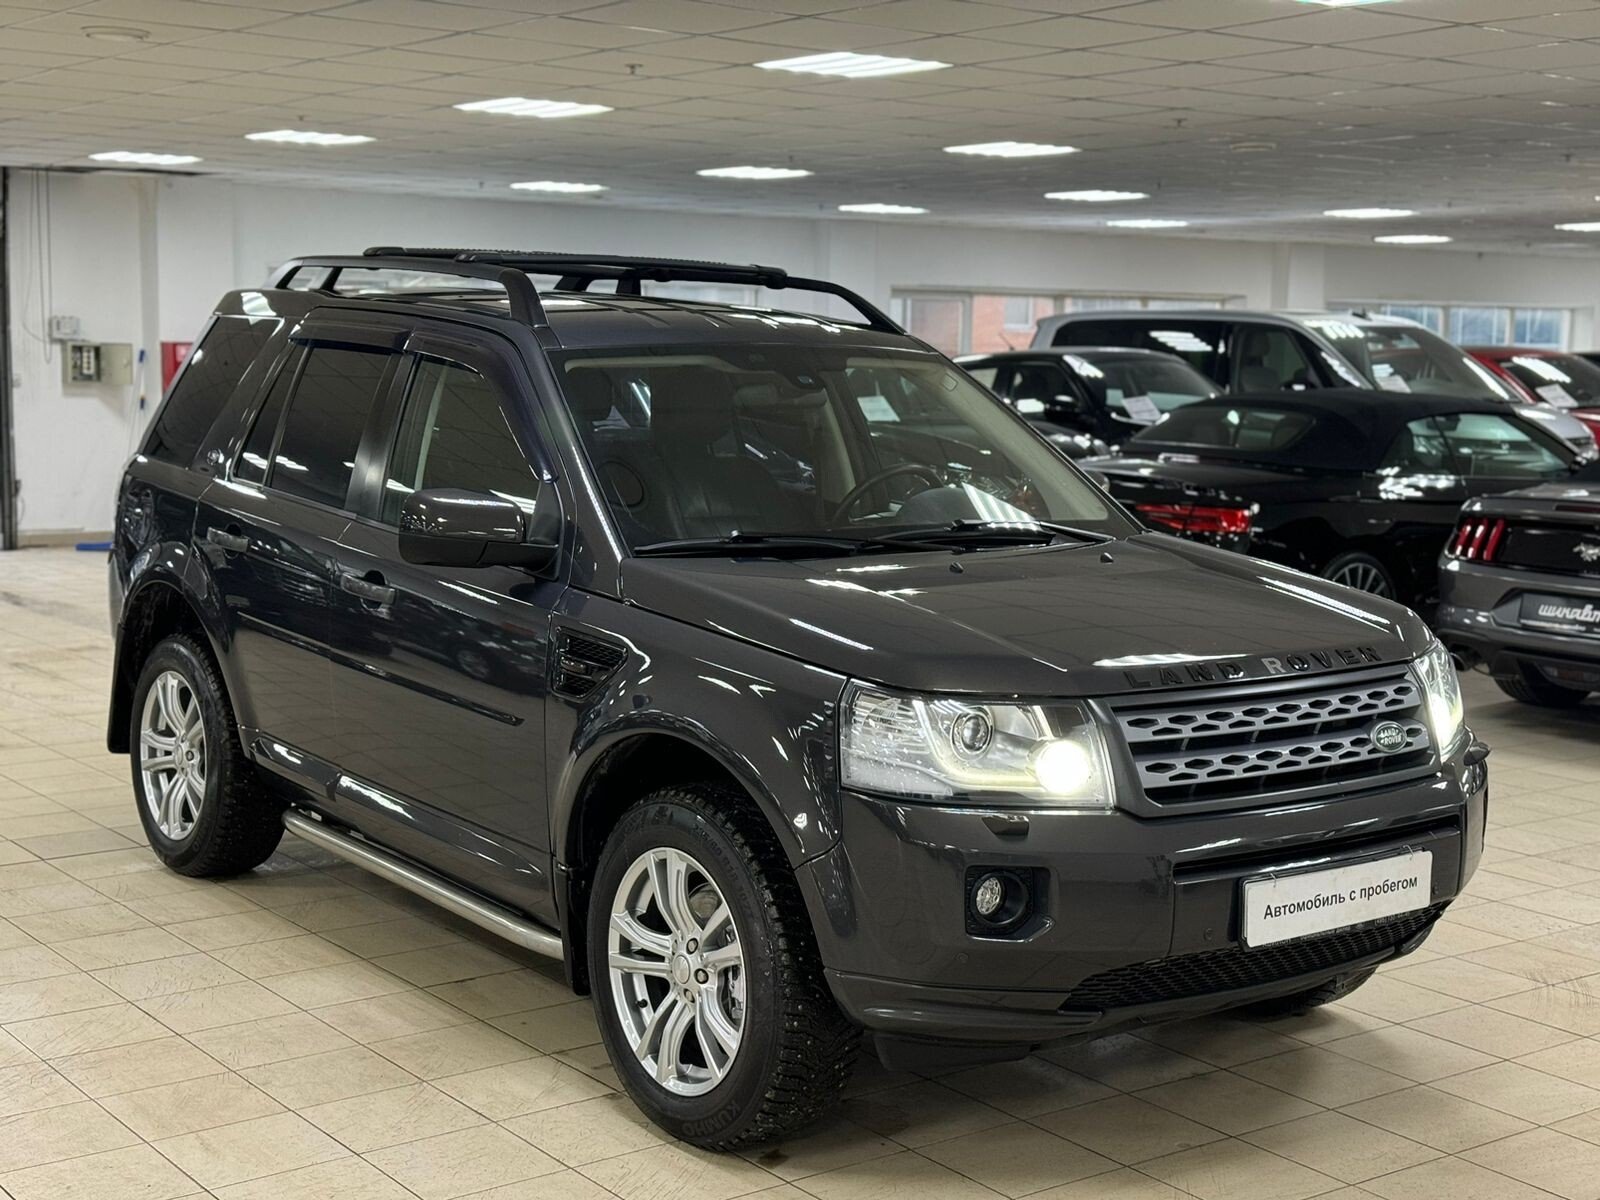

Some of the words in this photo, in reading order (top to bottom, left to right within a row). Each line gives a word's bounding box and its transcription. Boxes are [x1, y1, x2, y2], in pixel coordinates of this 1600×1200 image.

[1123, 661, 1245, 689] LAND
[1260, 646, 1383, 675] ROVER
[1378, 727, 1396, 739] LAND
[1383, 733, 1402, 746] ROVER
[1263, 893, 1346, 920] Автомобиль
[1349, 890, 1357, 901] с
[1359, 876, 1418, 901] пробегом
[681, 1099, 742, 1137] KUMHO
